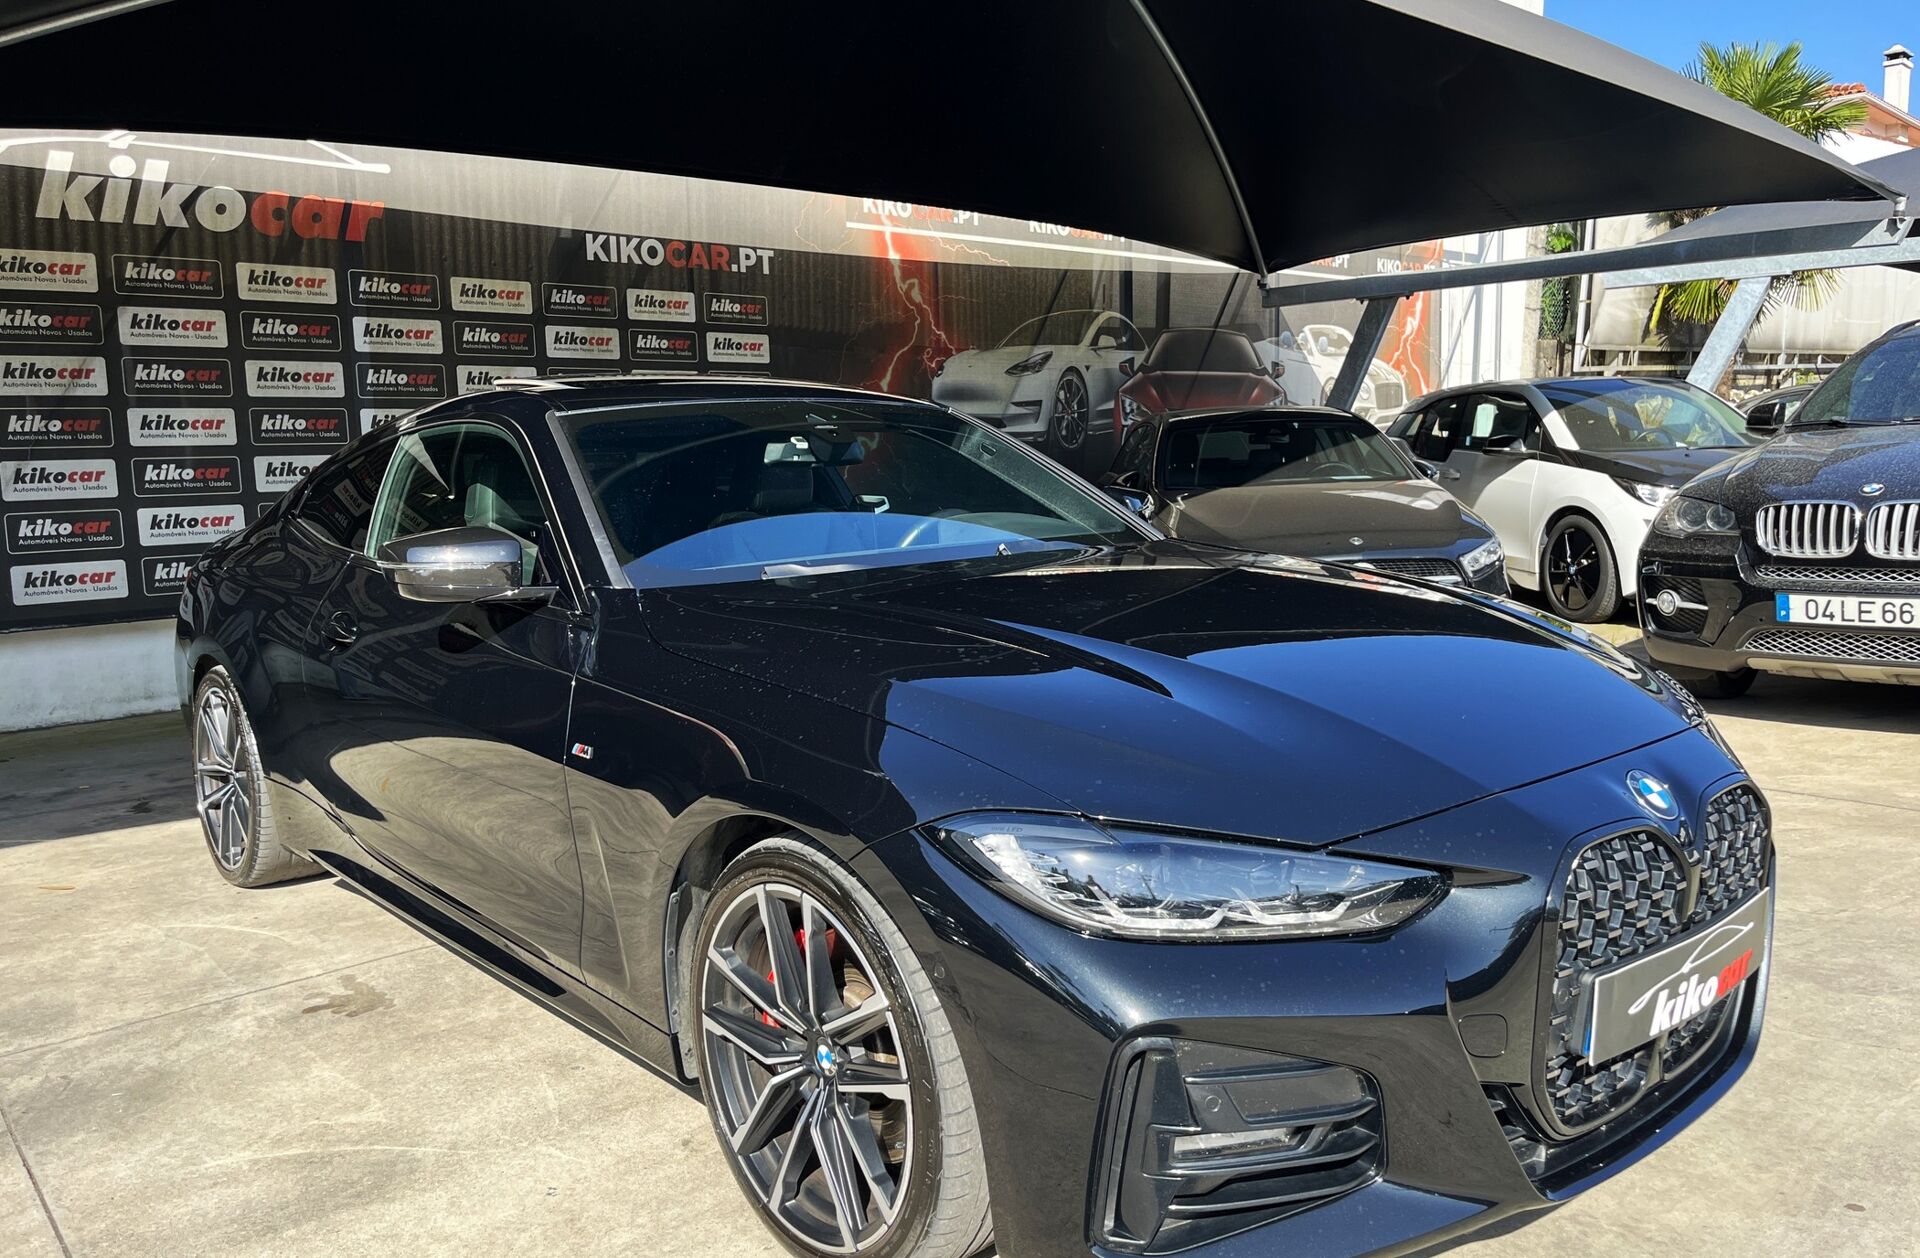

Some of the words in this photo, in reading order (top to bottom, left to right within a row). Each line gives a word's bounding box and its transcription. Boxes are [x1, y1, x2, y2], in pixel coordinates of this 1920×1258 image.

[35, 150, 384, 241] kikocar
[585, 232, 774, 275] KIKOCAR.PT
[125, 262, 211, 282] kikocar
[248, 269, 326, 288] kikocar
[359, 276, 430, 294] kikocar
[460, 283, 524, 300] kikocar
[551, 289, 609, 305] kikocar
[634, 294, 688, 309] kikocar
[711, 298, 761, 313] kikocar
[0, 309, 91, 327] kikocar
[130, 313, 216, 331] kikocar
[252, 318, 330, 336] kikocar
[363, 323, 433, 339] kikocar
[463, 327, 527, 343] kikocar
[554, 331, 612, 346] kikocar
[637, 335, 691, 348] kikocar
[713, 337, 763, 351] kikocar
[4, 362, 94, 379] kikocar
[135, 364, 220, 381] kikocar
[257, 366, 334, 382] kikocar
[367, 369, 436, 384] kikocar
[8, 415, 101, 431] kikocar
[140, 414, 225, 430] kikocar
[261, 414, 338, 429] kikocar
[13, 467, 106, 484] kikocar
[144, 464, 229, 480] kikocar
[266, 462, 316, 477] kiko
[18, 519, 111, 536] kikocar
[150, 513, 234, 530] kikocar
[24, 570, 116, 588] kikocar
[1649, 949, 1753, 1036] kikocar
